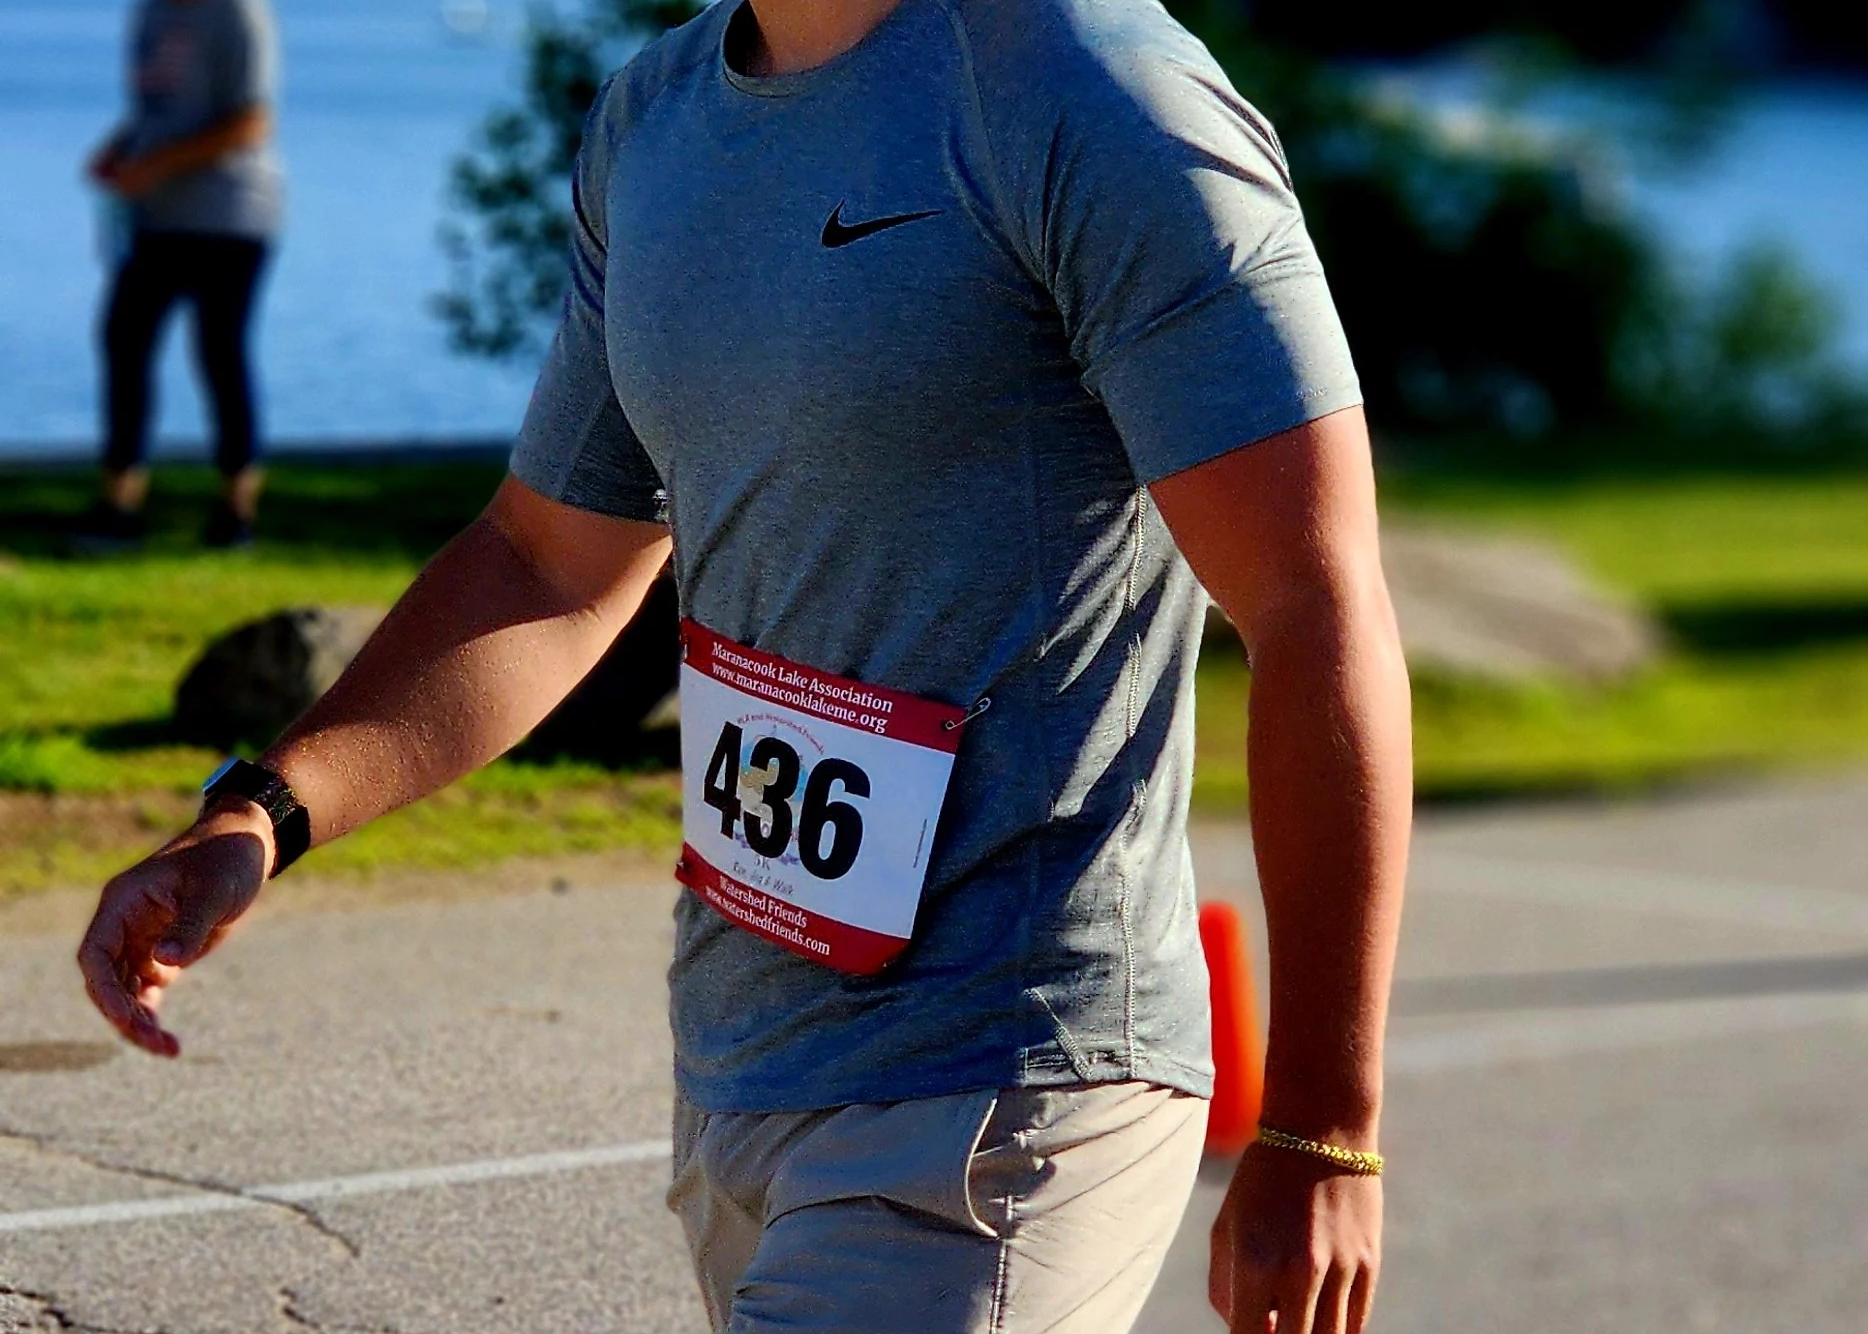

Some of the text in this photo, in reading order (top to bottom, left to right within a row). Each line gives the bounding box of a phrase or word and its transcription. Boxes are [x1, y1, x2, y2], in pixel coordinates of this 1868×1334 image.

[712, 642, 894, 713] Maranacook Lake Association
[712, 663, 888, 734] www.maranacooklakeme.org
[703, 720, 871, 881] 436
[719, 875, 808, 928] Watershed Friends
